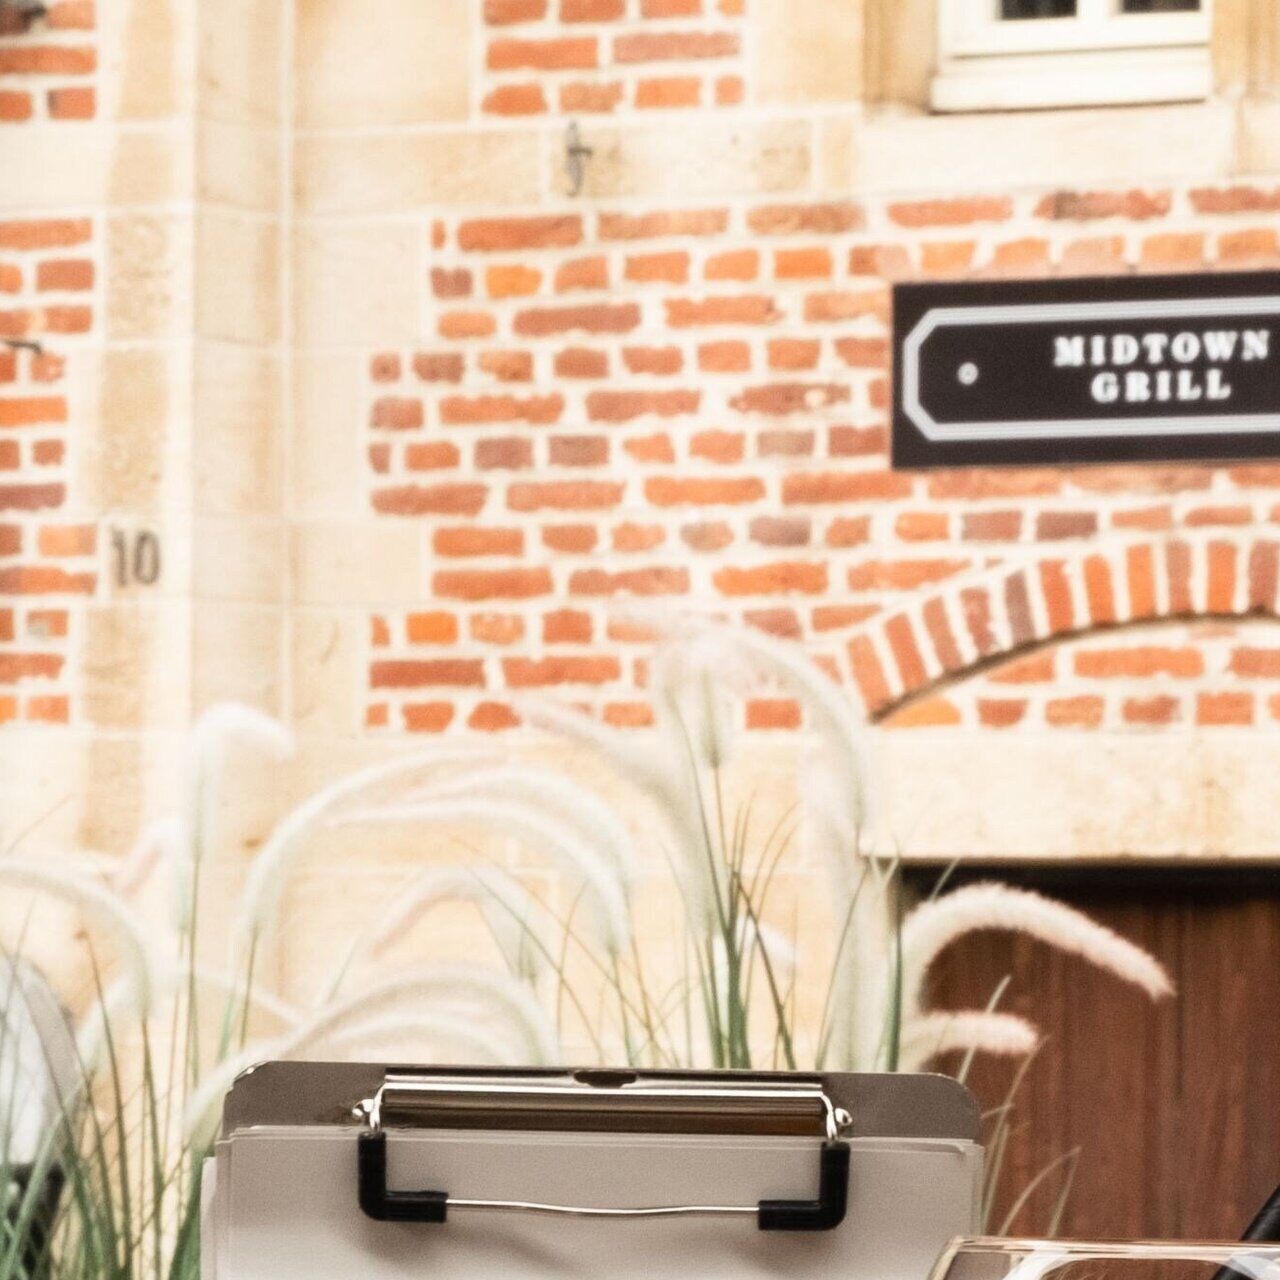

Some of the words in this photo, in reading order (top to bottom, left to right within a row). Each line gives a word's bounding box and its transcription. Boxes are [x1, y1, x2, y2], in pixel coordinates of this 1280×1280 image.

[1054, 330, 1270, 368] MIDTOWN
[1091, 369, 1232, 403] GRILL
[111, 527, 161, 588] 10
